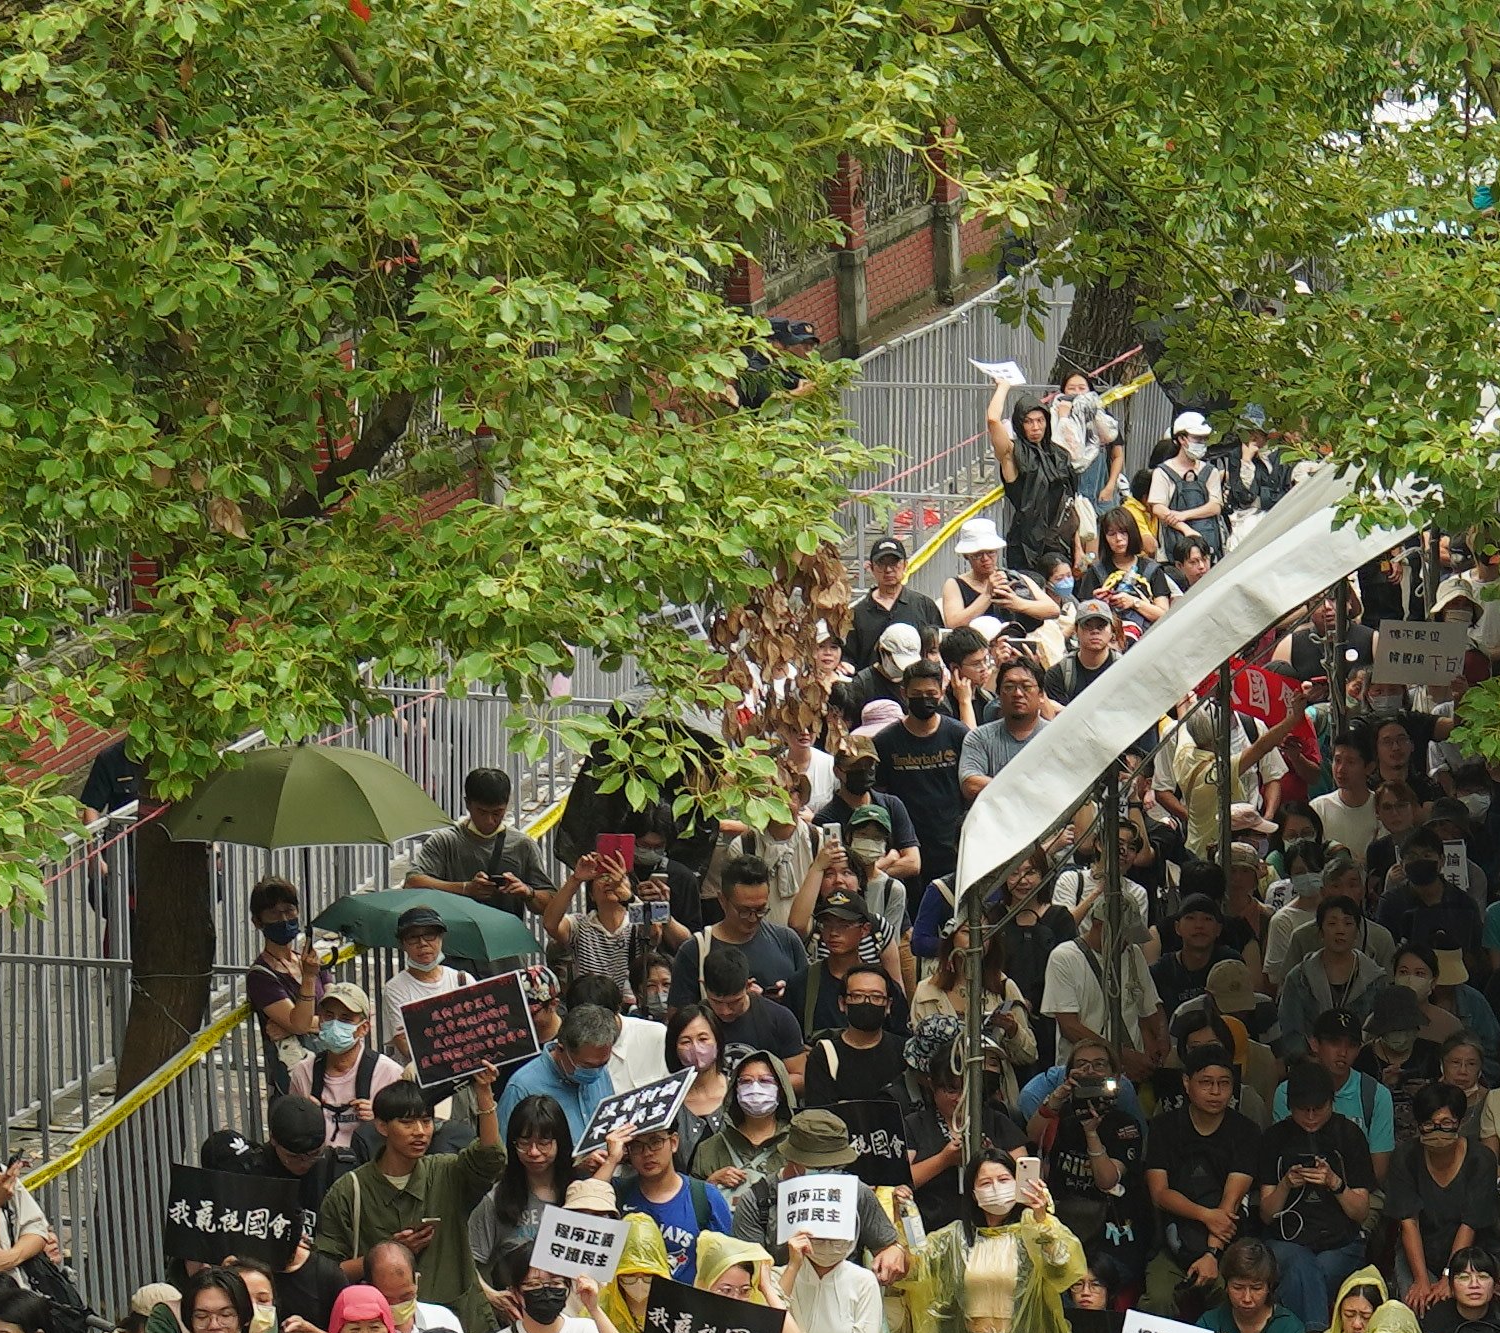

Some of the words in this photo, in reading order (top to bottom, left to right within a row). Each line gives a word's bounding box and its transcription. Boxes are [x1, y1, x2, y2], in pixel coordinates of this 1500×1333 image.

[169, 1199, 291, 1239] 我藐視國會
[555, 1223, 615, 1248] 程序正義
[550, 1241, 610, 1270] 守護民主
